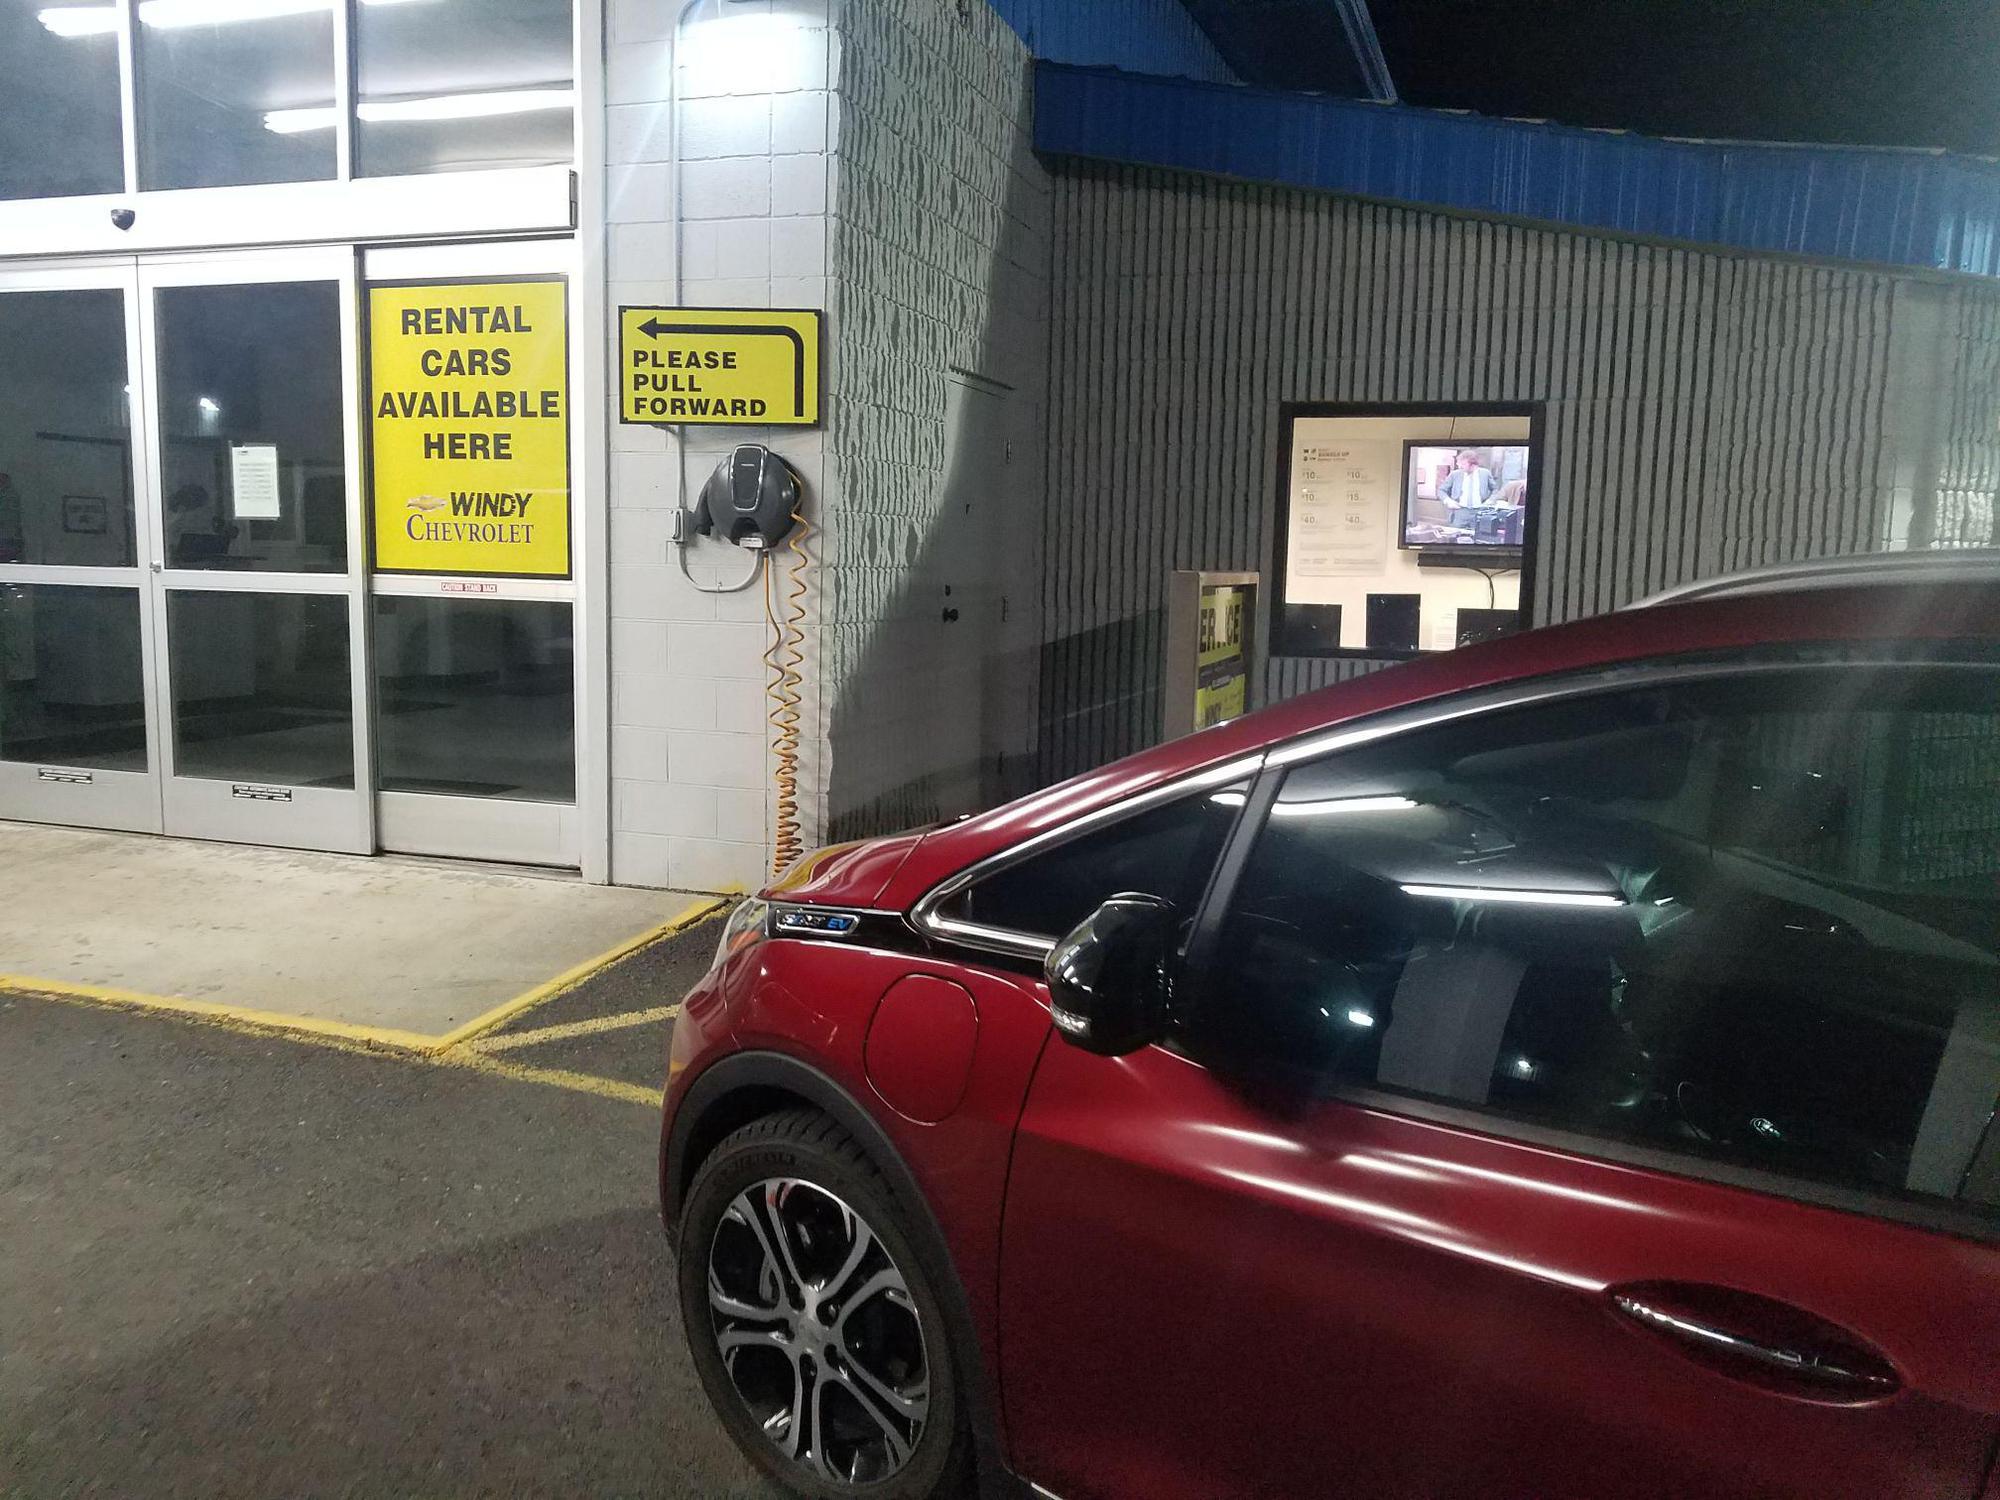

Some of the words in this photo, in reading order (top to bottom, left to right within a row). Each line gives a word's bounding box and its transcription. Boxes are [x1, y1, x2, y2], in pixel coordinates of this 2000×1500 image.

[401, 305, 532, 335] RENTAL
[421, 348, 512, 377] CARS
[633, 350, 737, 369] PLEASE
[633, 374, 702, 392] PULL
[377, 391, 560, 418] AVAILABLE
[634, 397, 767, 416] FORWARD
[424, 433, 512, 460] HERE
[450, 492, 533, 517] WINDY
[406, 514, 535, 543] CHEVROLET
